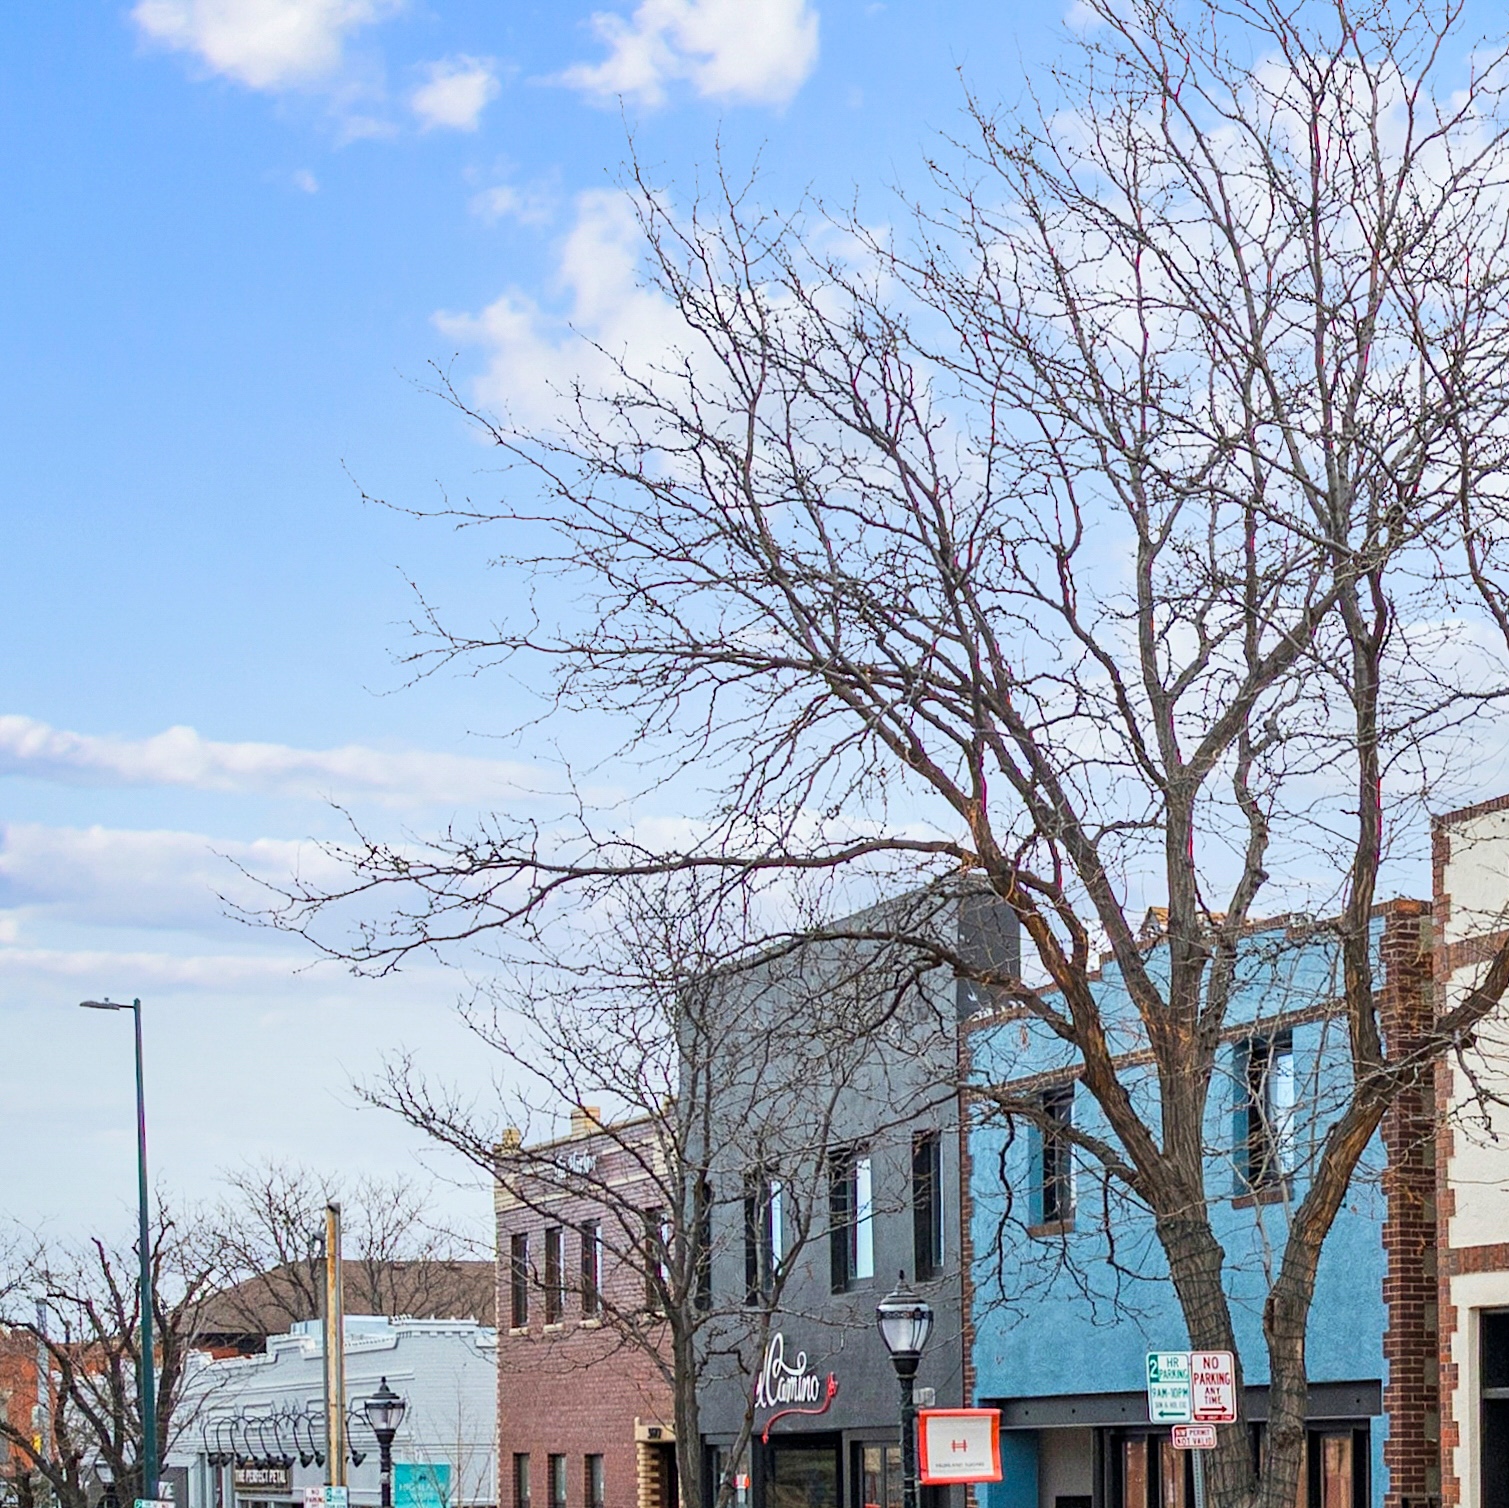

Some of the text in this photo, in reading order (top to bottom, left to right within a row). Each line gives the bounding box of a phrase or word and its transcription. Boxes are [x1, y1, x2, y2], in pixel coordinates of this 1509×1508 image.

[1150, 1357, 1179, 1378] 2 HR
[1203, 1357, 1219, 1369] NO
[765, 1332, 820, 1407] Camino
[1159, 1369, 1189, 1380] PARKING
[1193, 1372, 1231, 1385] PARKING
[1205, 1387, 1220, 1395] ANY
[1205, 1396, 1222, 1404] TIME
[234, 1469, 287, 1484] THE PERFECT PETAL
